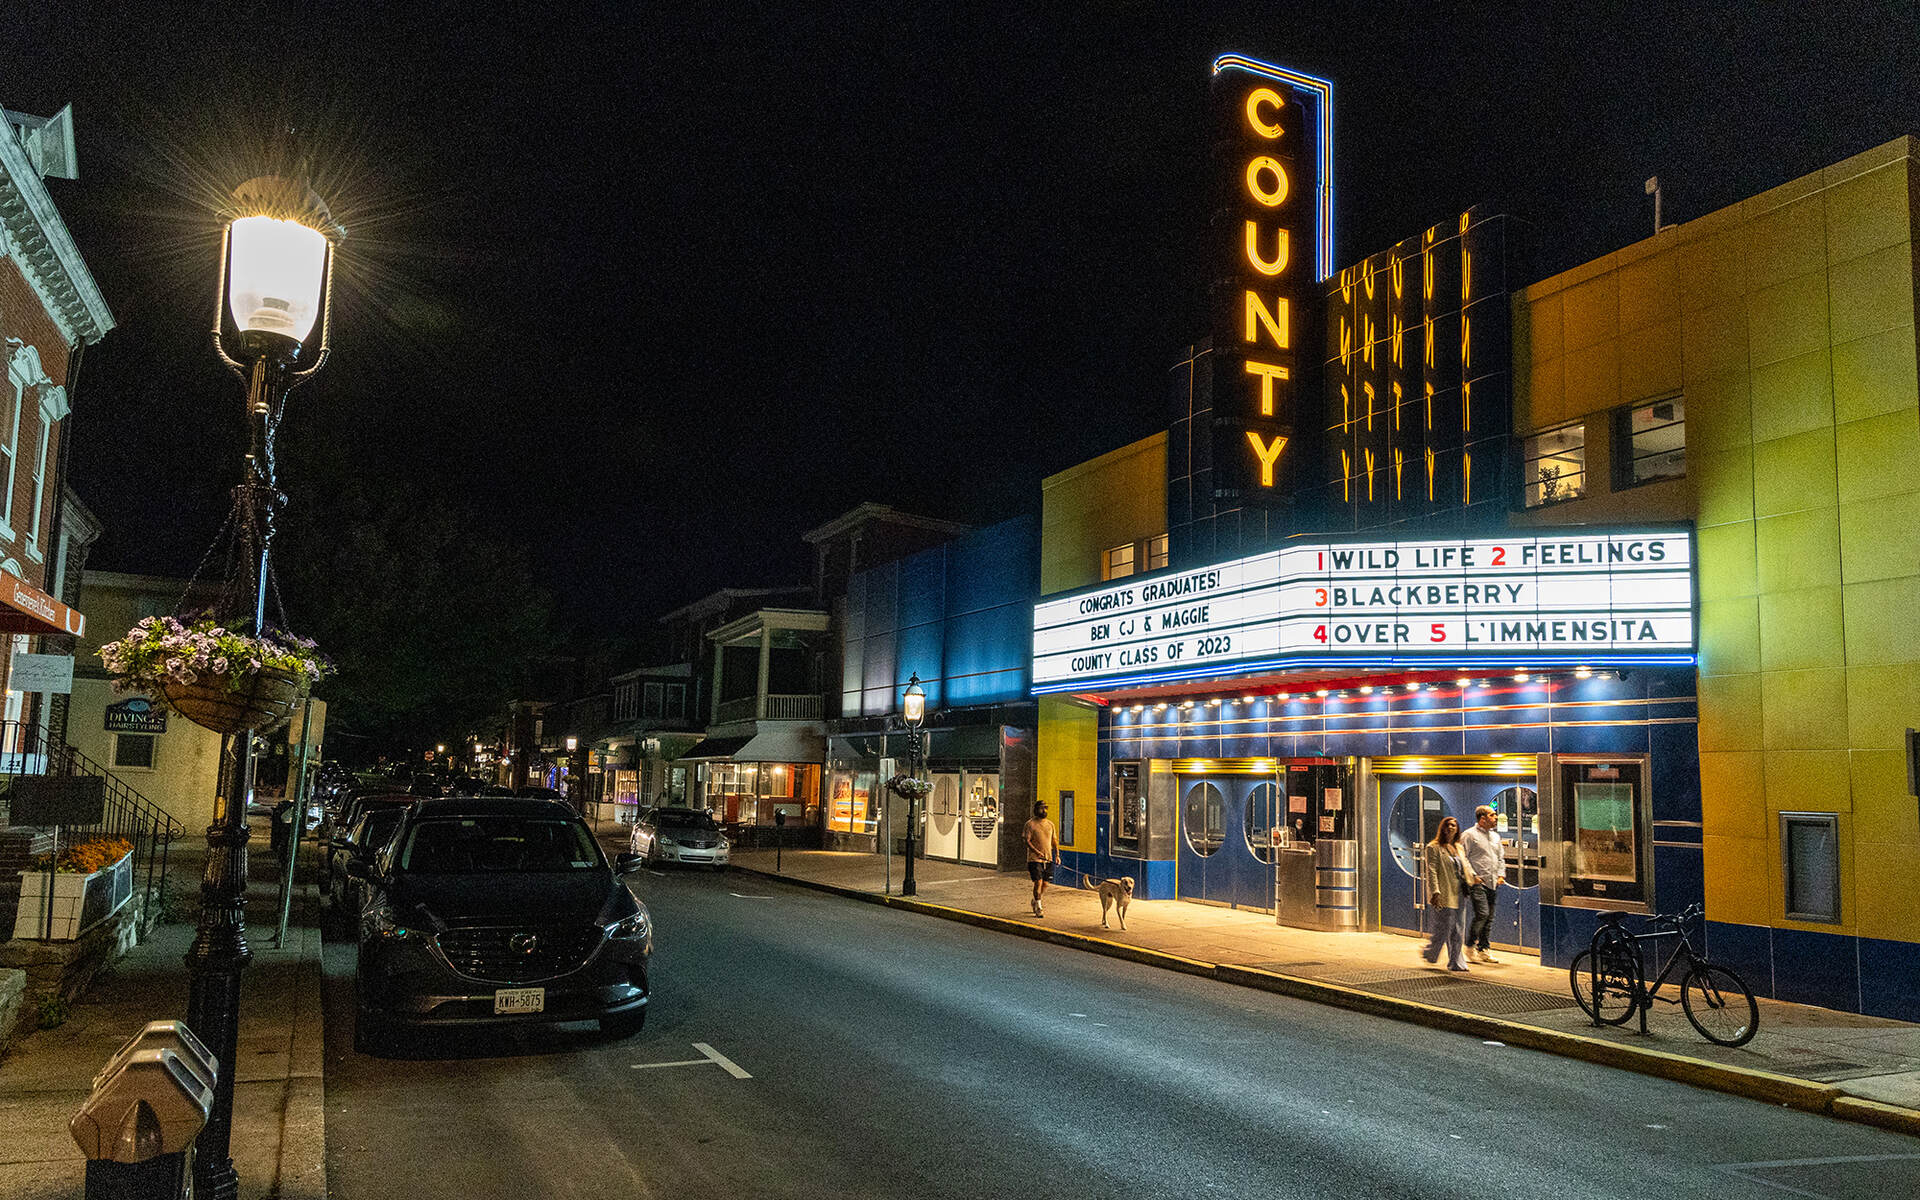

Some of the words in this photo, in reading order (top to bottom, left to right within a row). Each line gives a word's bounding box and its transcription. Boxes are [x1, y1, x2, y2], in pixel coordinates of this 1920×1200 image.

[1246, 87, 1289, 488] COUNTY
[1317, 552, 1323, 571] 1
[1332, 549, 1400, 570] WILD
[1416, 547, 1475, 568] LIFE
[1491, 547, 1506, 566] 2
[1522, 542, 1666, 566] FEELINGS
[1080, 590, 1134, 614] CONGRATS
[1142, 571, 1221, 602] GRADUATES!
[1315, 588, 1328, 607] 3
[1334, 583, 1524, 607] BLACKBERRY
[1091, 624, 1110, 641] BEN
[1119, 619, 1135, 636] CJ
[1144, 616, 1152, 632] &
[1162, 606, 1209, 630] MAGGIE
[1313, 625, 1328, 644] 4
[1334, 623, 1410, 644] OVER
[1430, 623, 1447, 643] 5
[1465, 620, 1658, 643] L'IMMENSITA
[1071, 653, 1112, 672] COUNTY
[1119, 647, 1158, 666] CLASS
[1167, 642, 1185, 660] OF
[1197, 636, 1231, 656] 2023
[109, 722, 163, 730] HAIRSTYLING
[499, 994, 541, 1008] KWH-5875
